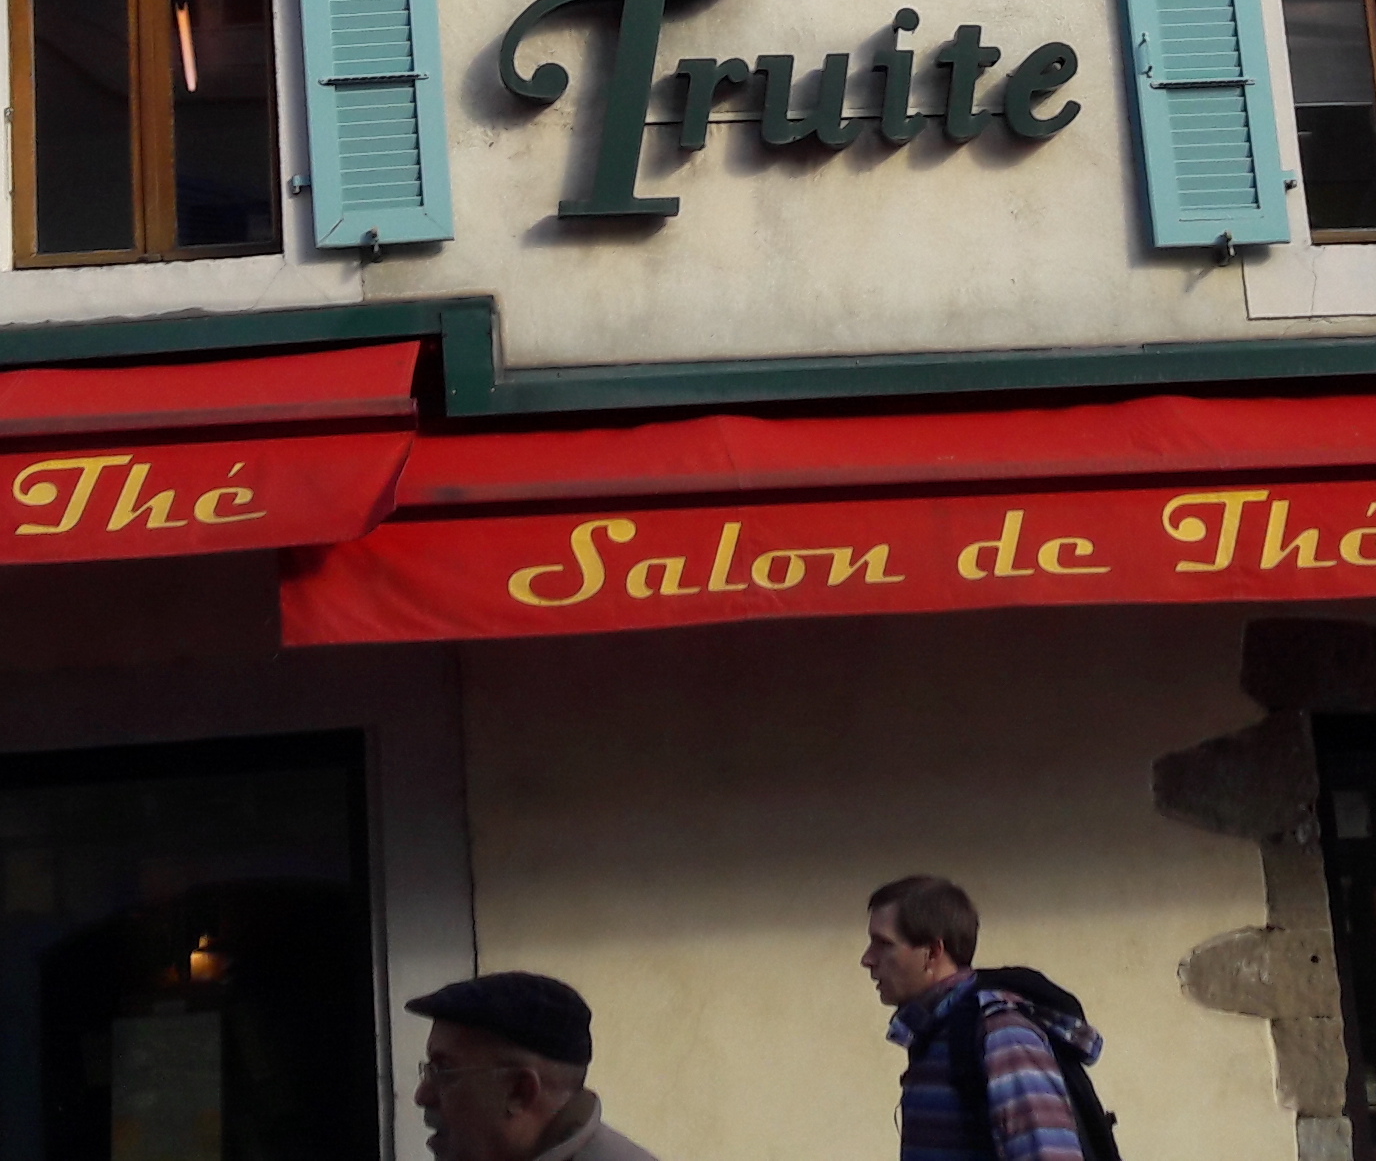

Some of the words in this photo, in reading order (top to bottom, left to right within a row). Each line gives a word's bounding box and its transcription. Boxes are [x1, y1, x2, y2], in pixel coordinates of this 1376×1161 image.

[12, 454, 267, 537] Thé
[507, 517, 906, 608] Salon
[956, 509, 1111, 580] de
